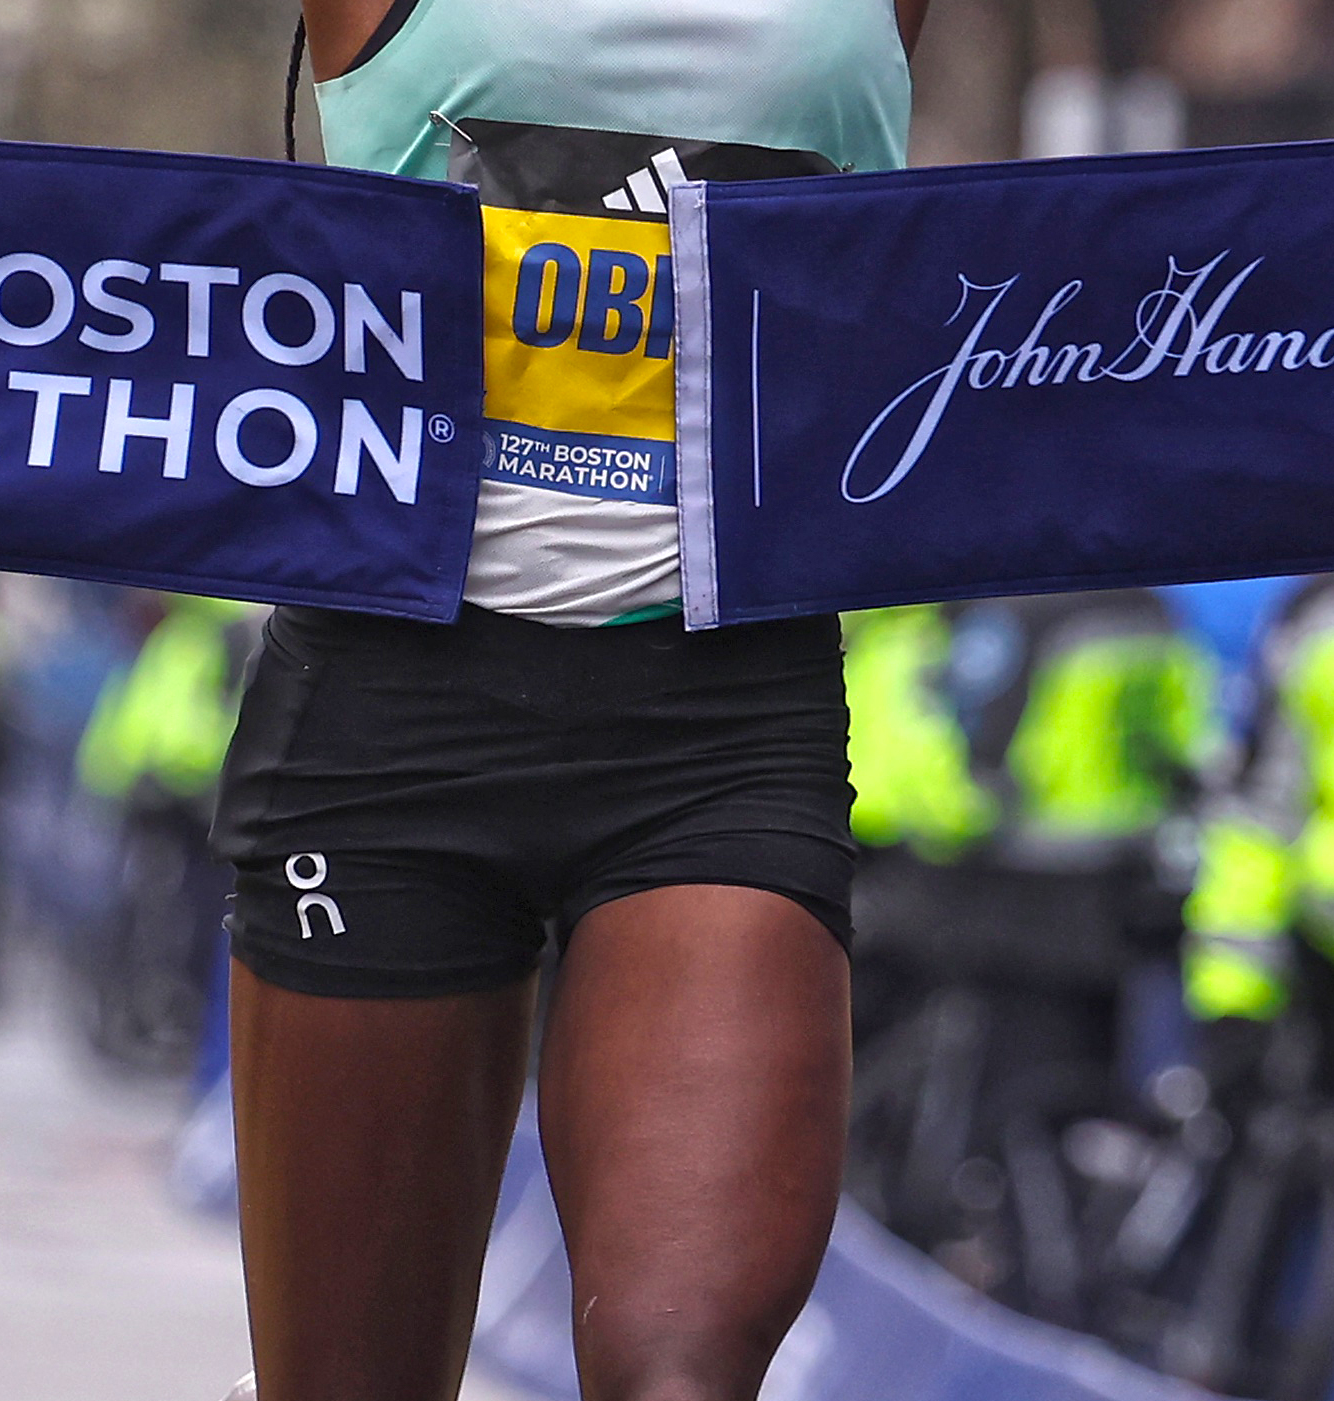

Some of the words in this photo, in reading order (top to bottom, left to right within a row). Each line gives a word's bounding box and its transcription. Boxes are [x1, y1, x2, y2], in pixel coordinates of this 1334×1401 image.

[500, 433, 551, 456] 127TH
[554, 444, 651, 471] BOSTON
[841, 273, 1104, 504] John
